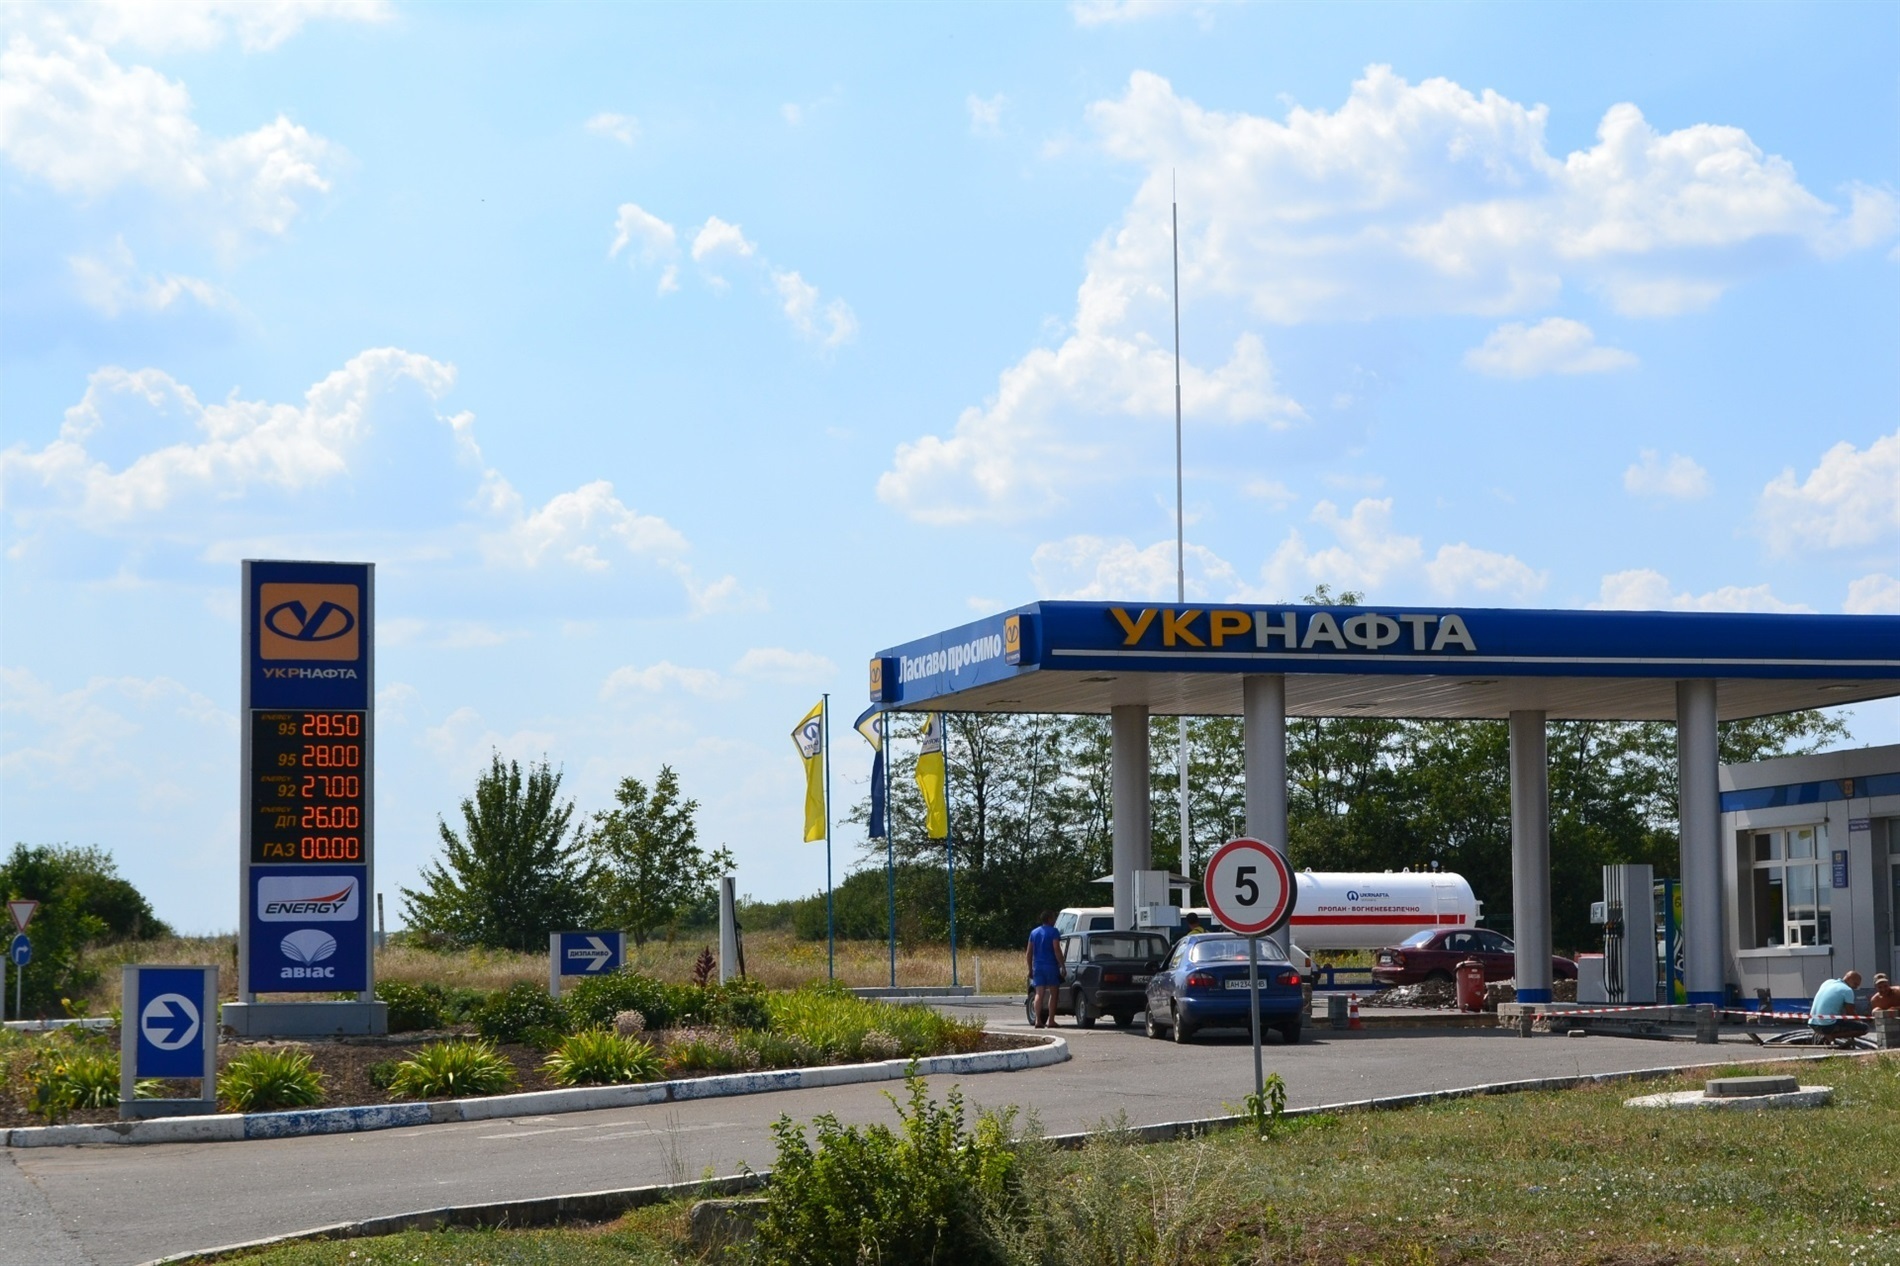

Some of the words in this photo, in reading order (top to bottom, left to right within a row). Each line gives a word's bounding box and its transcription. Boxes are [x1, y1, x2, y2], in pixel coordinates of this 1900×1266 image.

[1108, 607, 1477, 652] УКРНАФТА
[898, 650, 946, 684] Ласкаво
[948, 634, 1002, 676] просимо
[263, 667, 358, 679] УКРНАФТА
[278, 722, 297, 736] 95
[302, 714, 359, 737] 28.50
[278, 753, 297, 767] 95
[302, 745, 359, 767] 28.00
[277, 784, 296, 797] 92
[302, 776, 359, 798] 27.00
[275, 815, 296, 829] ДП
[302, 806, 359, 829] 26.00
[263, 843, 296, 857] ГАЗ
[301, 837, 358, 859] 00.00
[1234, 866, 1259, 906] 5
[265, 903, 345, 914] ENERGY
